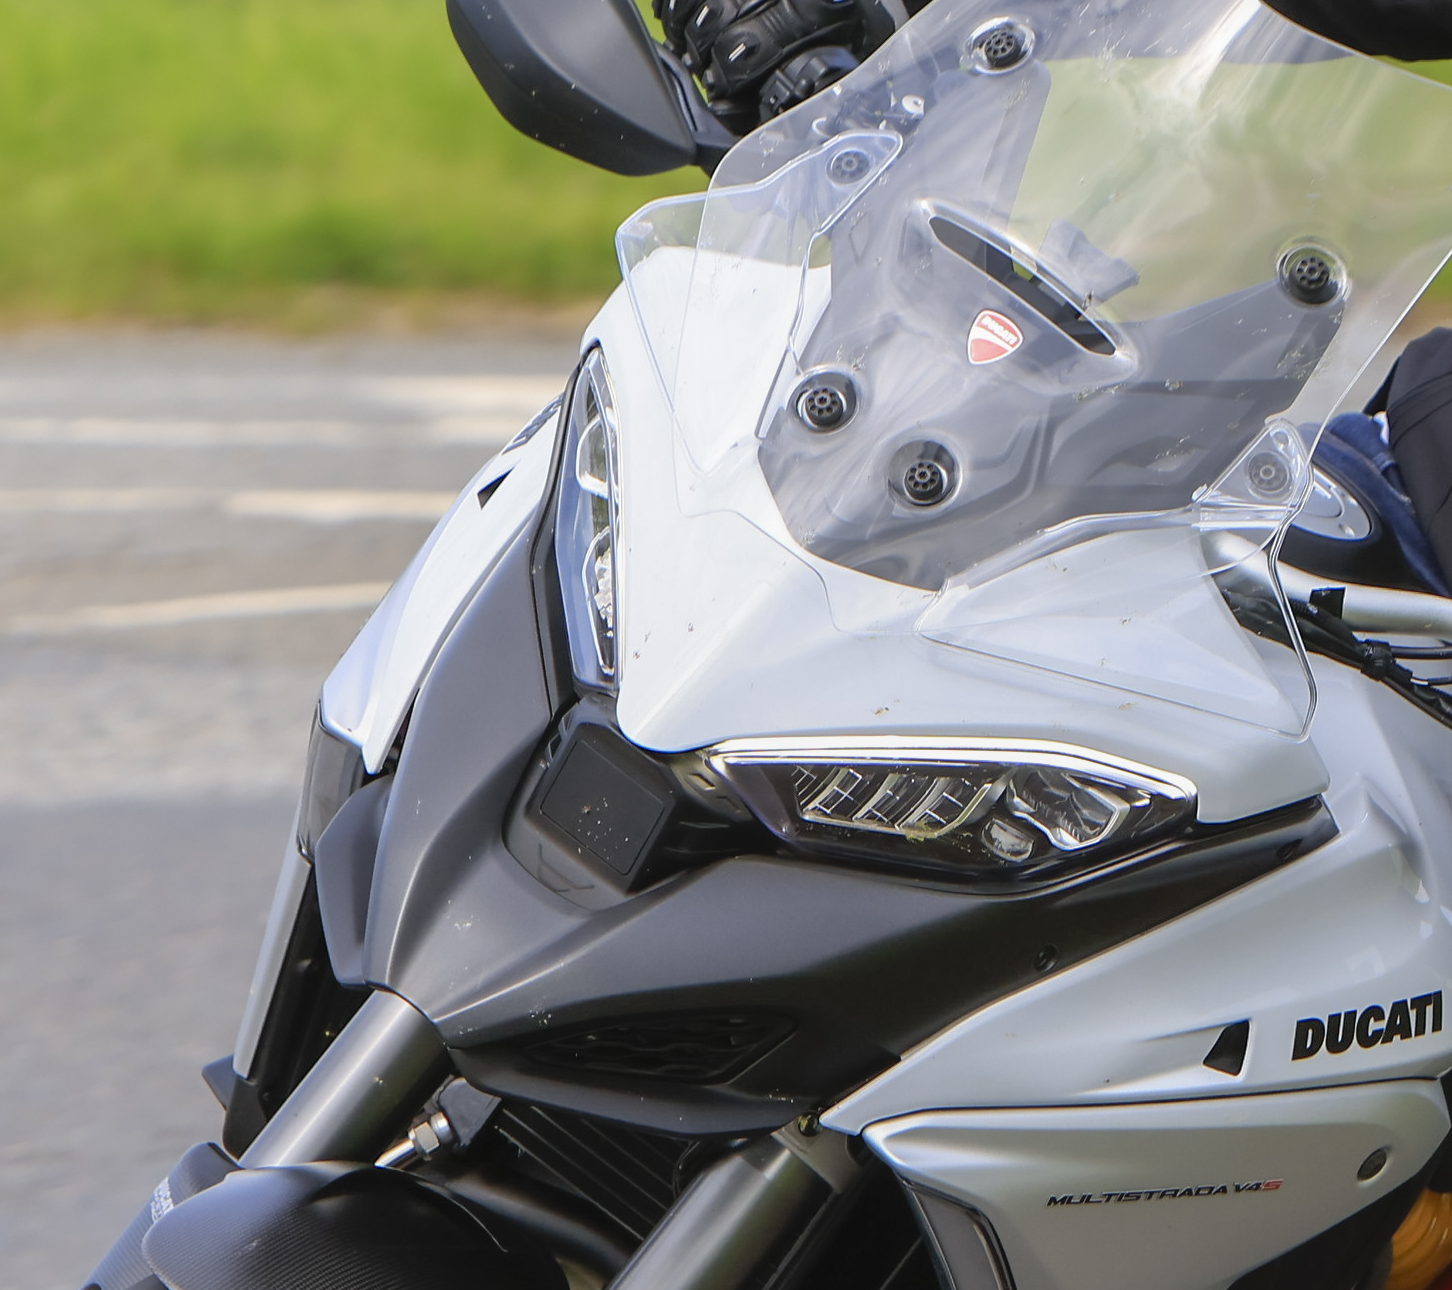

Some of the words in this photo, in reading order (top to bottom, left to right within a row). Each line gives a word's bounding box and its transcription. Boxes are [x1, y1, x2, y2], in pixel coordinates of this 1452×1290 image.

[1291, 990, 1443, 1062] DUCATI
[1047, 1183, 1228, 1207] MULTISTRADA
[1234, 1177, 1285, 1193] V4S
